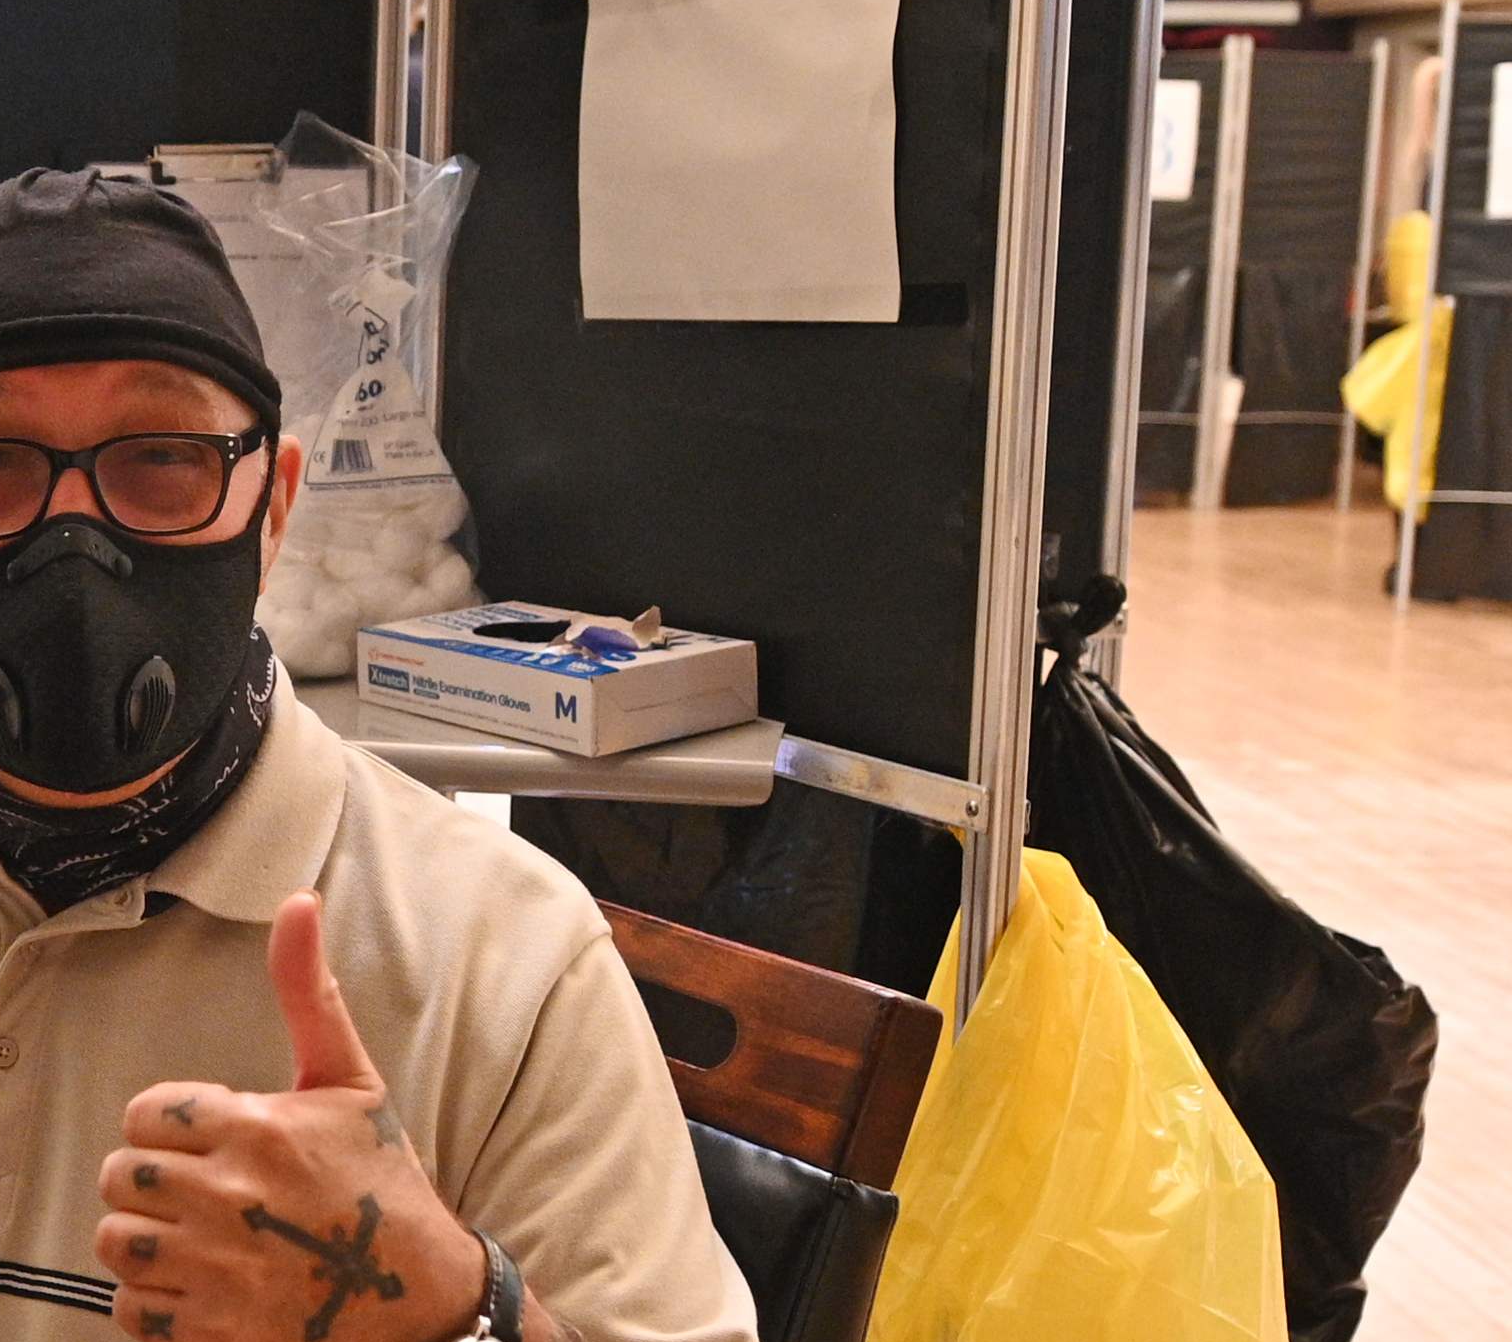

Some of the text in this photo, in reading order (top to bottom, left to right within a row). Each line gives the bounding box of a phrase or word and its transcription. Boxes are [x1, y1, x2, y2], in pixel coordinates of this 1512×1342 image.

[412, 675, 438, 692] Nitrile
[439, 679, 498, 705] Examination
[498, 693, 531, 713] Gloves
[554, 692, 577, 724] M
